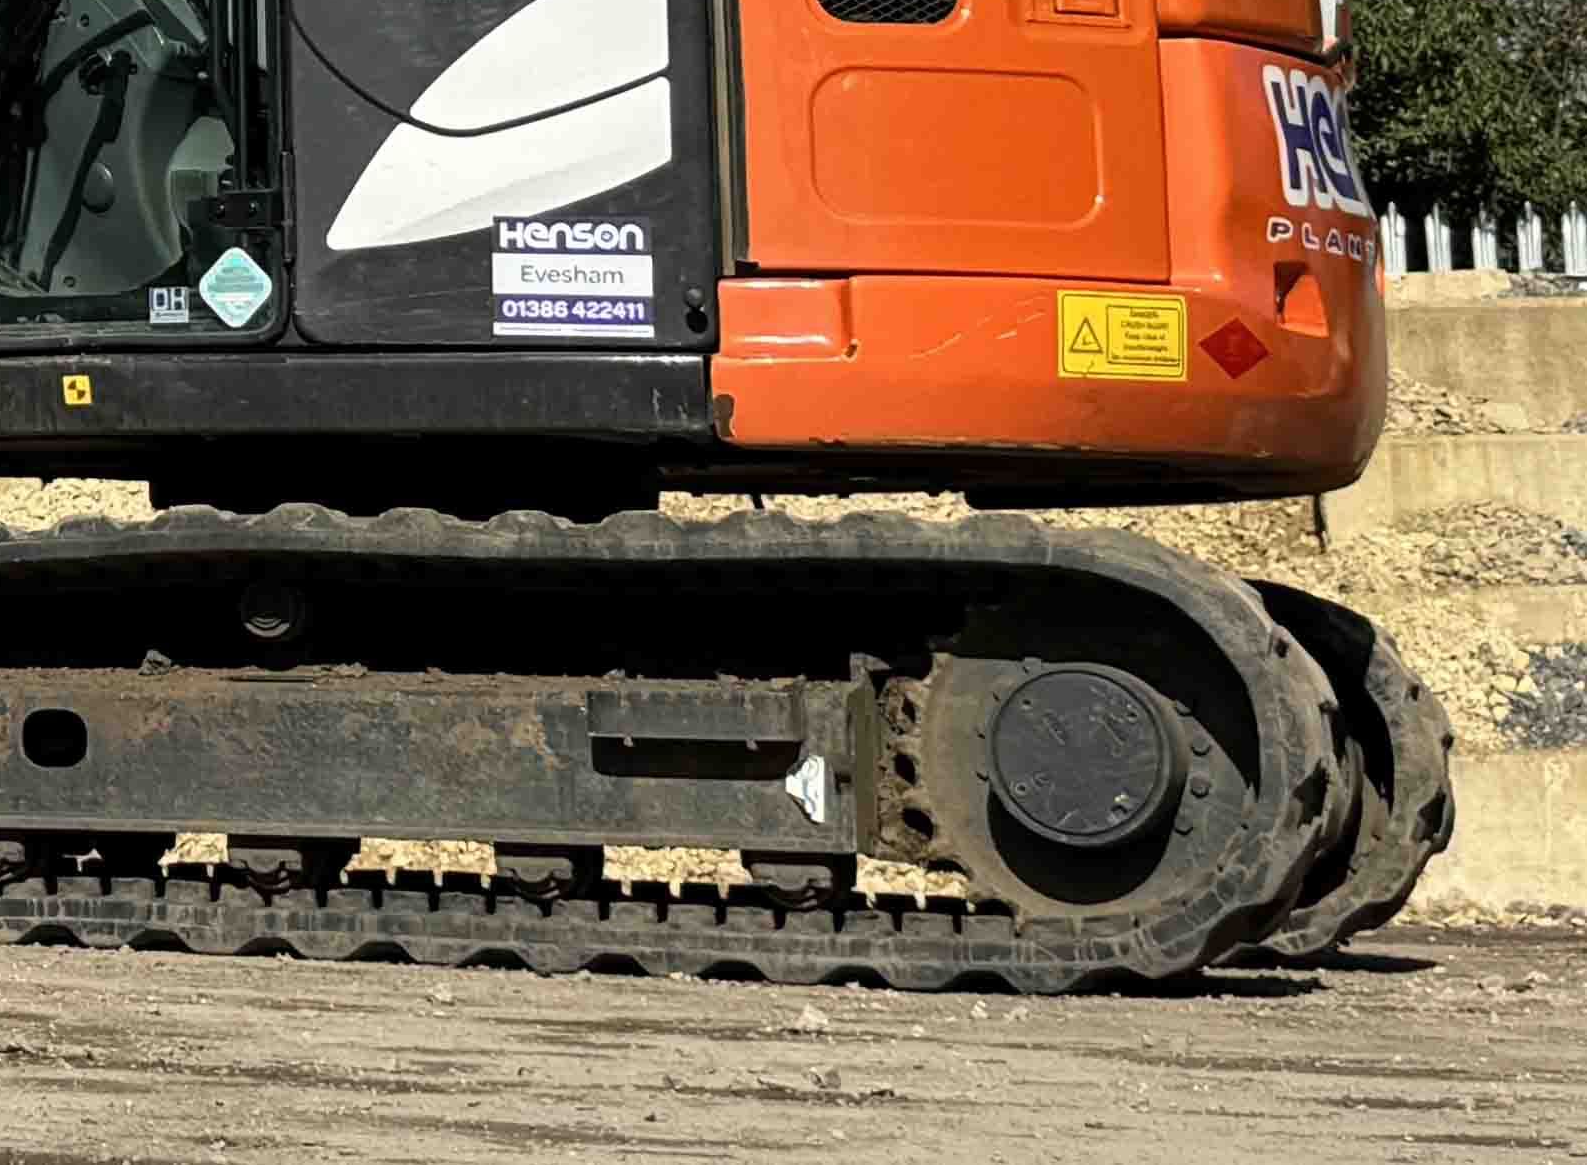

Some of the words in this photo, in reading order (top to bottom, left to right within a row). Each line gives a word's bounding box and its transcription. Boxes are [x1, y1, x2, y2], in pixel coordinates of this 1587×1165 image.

[498, 221, 645, 251] Henson
[520, 264, 624, 284] Evesham
[501, 299, 569, 319] 01386
[571, 300, 646, 321] 422411
